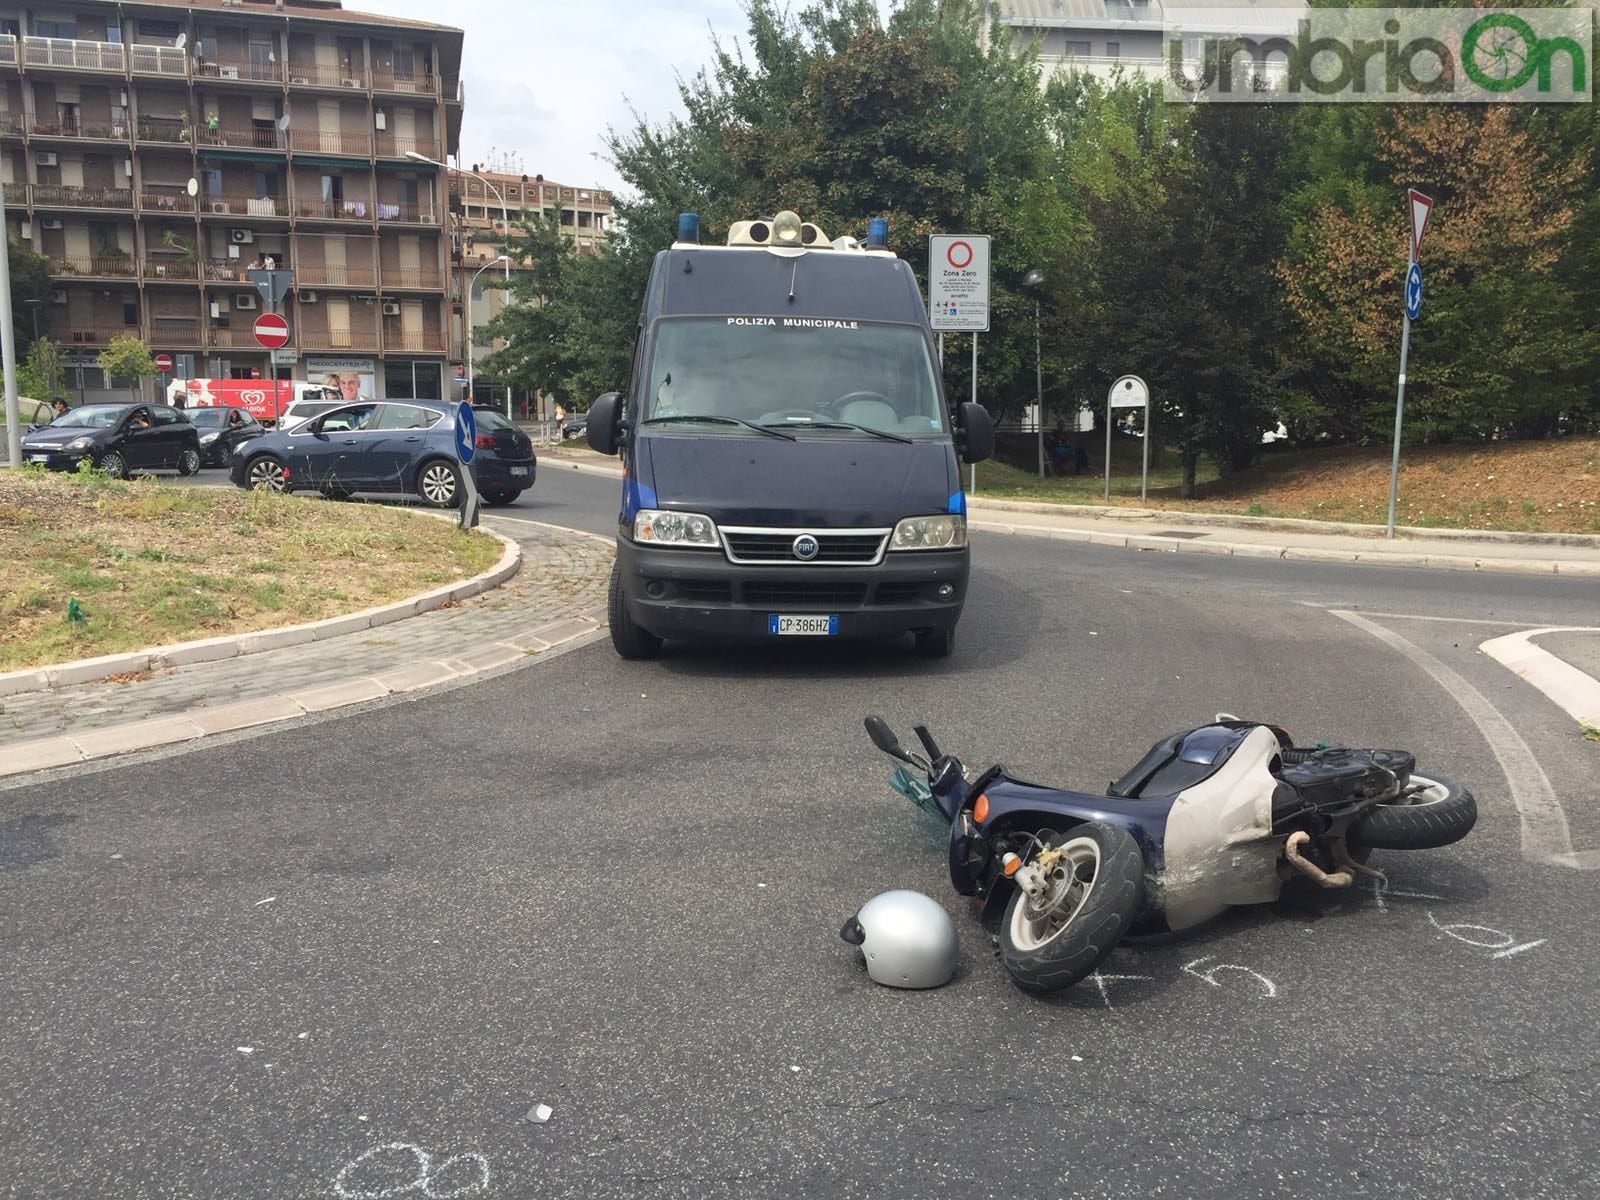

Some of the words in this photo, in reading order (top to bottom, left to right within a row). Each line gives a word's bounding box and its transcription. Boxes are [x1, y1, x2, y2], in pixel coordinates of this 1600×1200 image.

[727, 317, 777, 326] POLIZIA
[783, 318, 859, 330] MUNICIPALE
[309, 360, 361, 369] MEDICENTER
[798, 543, 814, 552] FIAT
